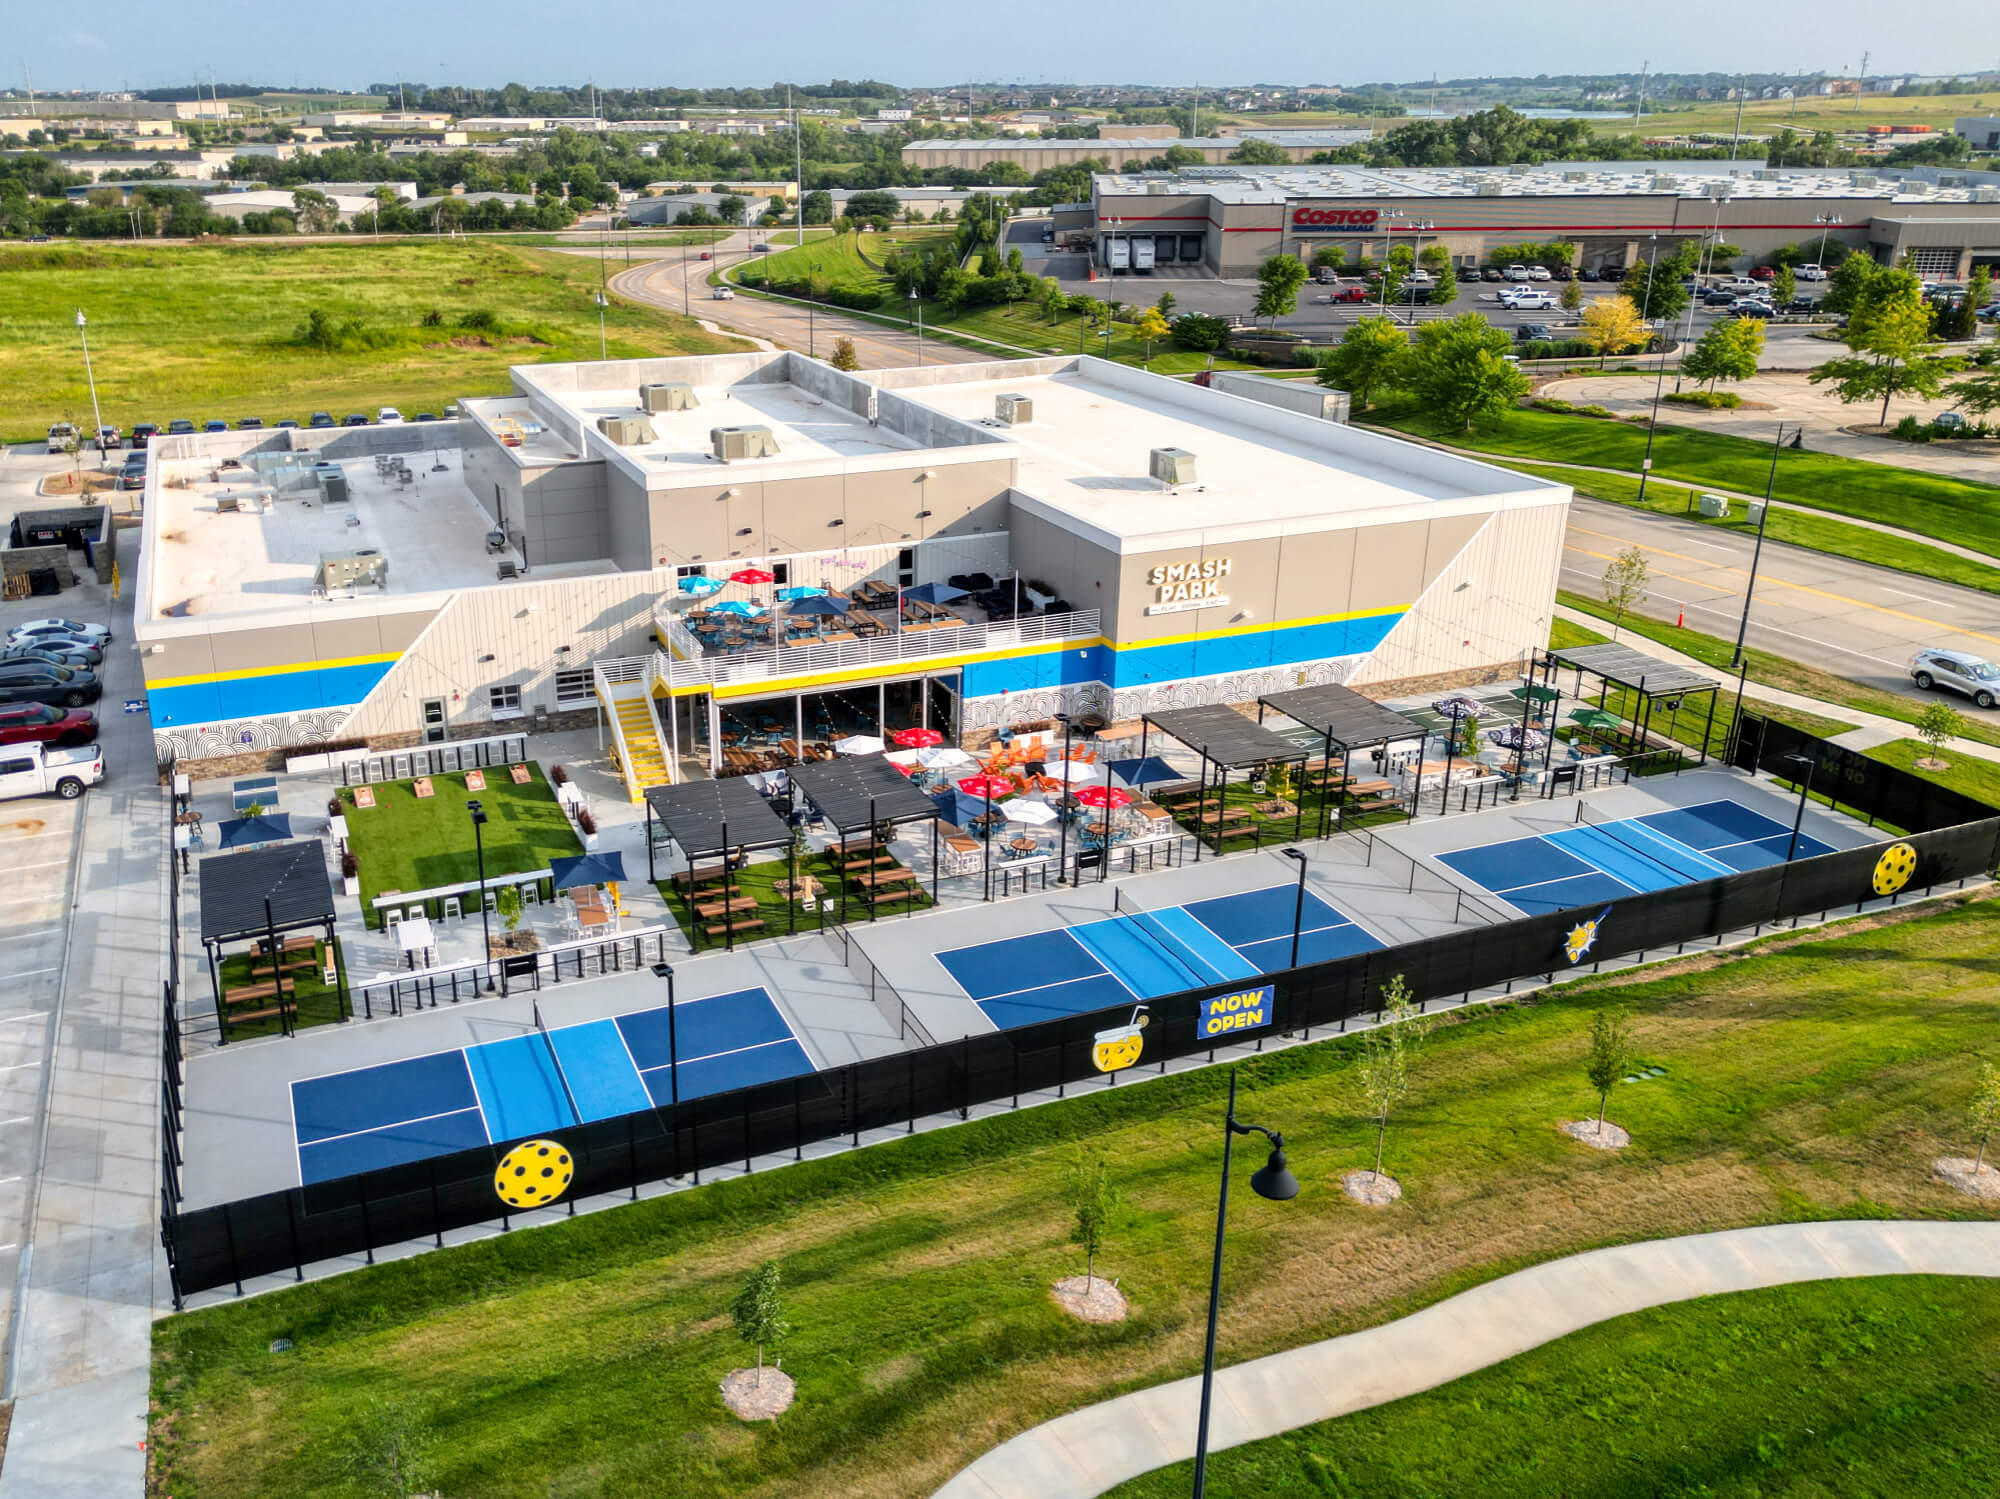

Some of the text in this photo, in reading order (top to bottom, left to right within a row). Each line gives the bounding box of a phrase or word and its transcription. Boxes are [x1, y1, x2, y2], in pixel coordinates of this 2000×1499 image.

[1292, 208, 1379, 224] COSTCO
[1151, 558, 1232, 584] SMASH
[1160, 579, 1220, 603] PARK
[1210, 990, 1264, 1015] NOW
[1206, 1009, 1263, 1034] OPEN
